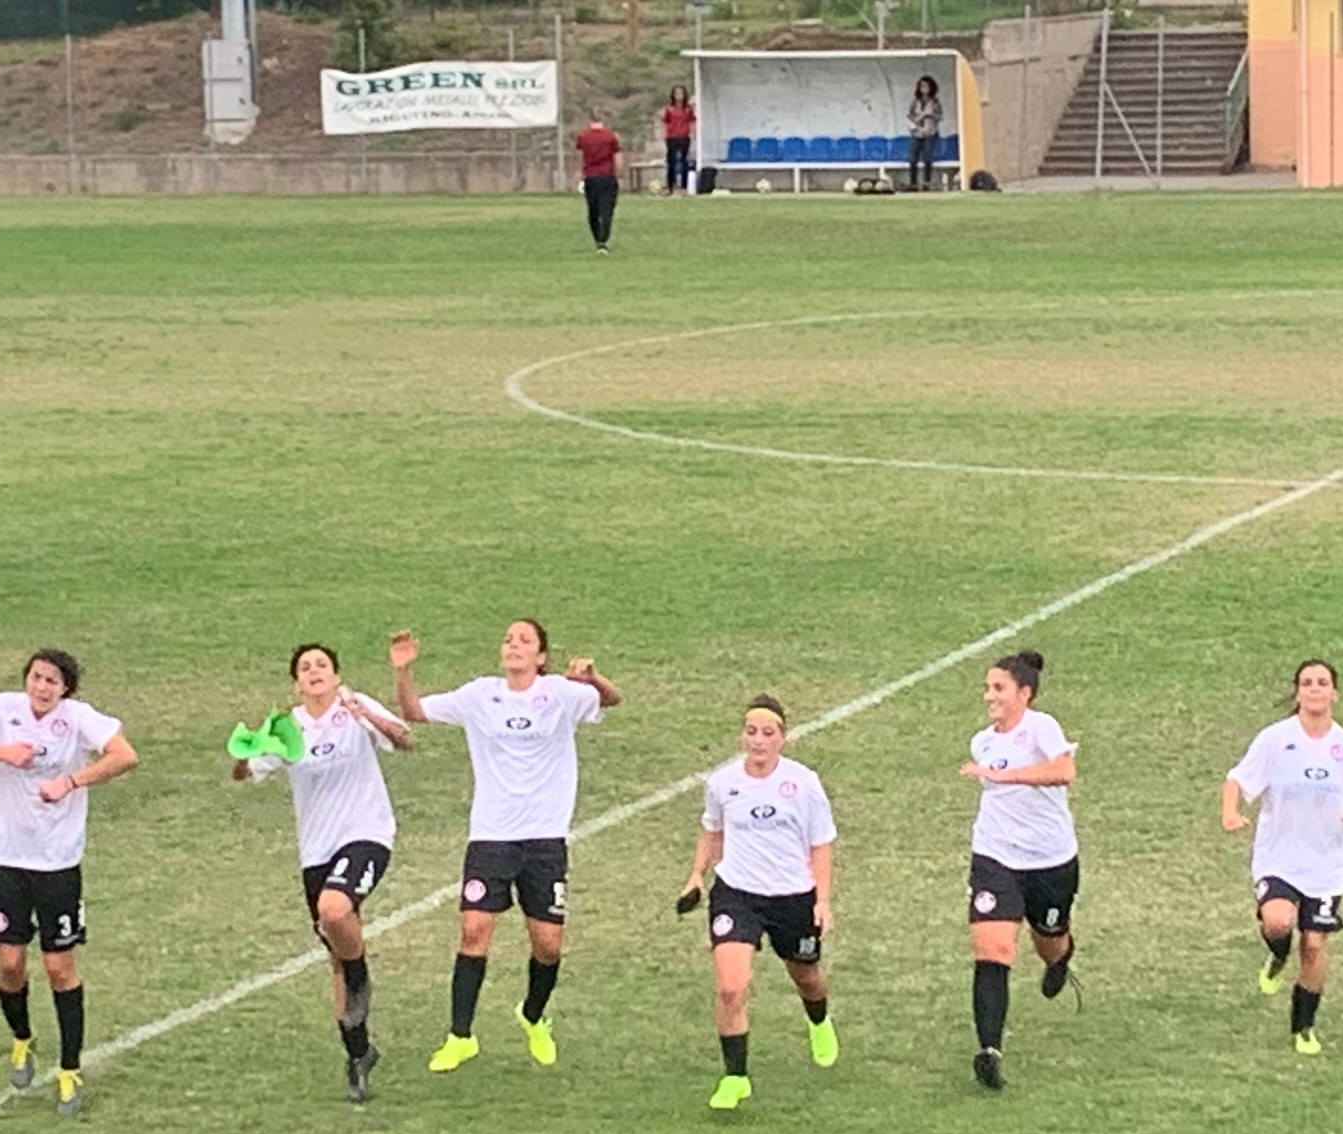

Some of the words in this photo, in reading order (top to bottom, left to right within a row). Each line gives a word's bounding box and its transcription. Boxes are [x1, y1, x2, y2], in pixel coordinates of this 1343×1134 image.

[336, 71, 485, 96] GREEN
[495, 78, 545, 90] SRL
[58, 914, 72, 937] 3
